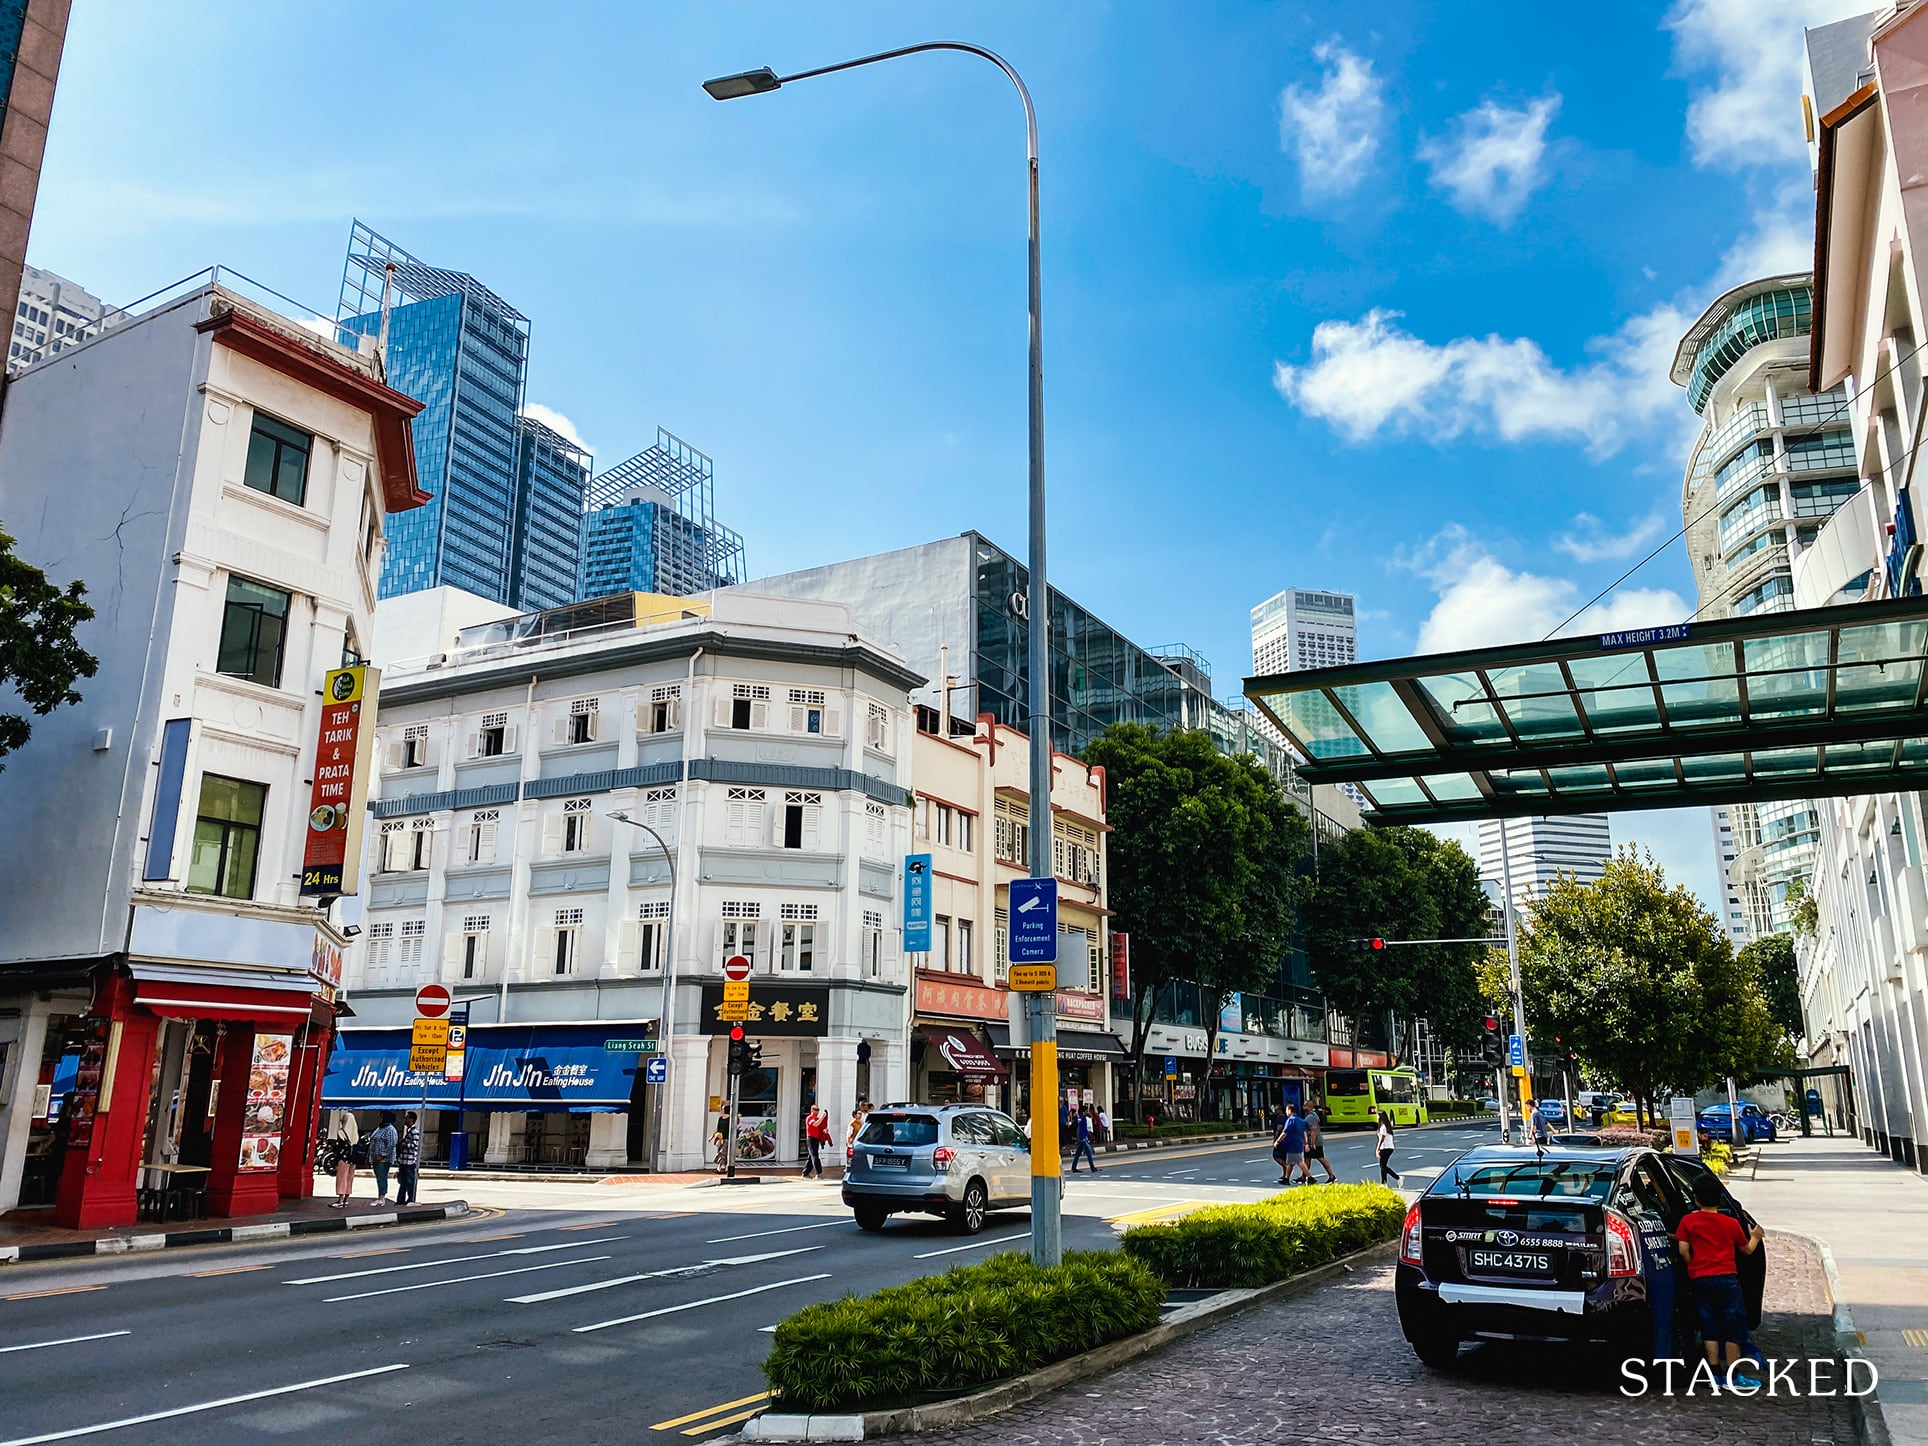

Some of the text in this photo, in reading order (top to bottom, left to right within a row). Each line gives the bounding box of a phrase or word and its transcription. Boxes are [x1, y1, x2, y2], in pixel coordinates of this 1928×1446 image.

[1602, 627, 1680, 646] MAX HEIGHT 3.2M
[332, 711, 349, 726] TEH
[325, 728, 352, 743] TARIK
[332, 747, 340, 760] &
[319, 764, 349, 780] PRATA
[321, 783, 344, 797] TIME
[304, 871, 339, 886] 24 Hrs
[1022, 922, 1044, 930] Parking
[1015, 934, 1051, 943] Enforcement
[417, 1046, 439, 1055] Except
[607, 1041, 655, 1051] Liang Seah St
[411, 1055, 445, 1063] Authorised
[404, 1076, 426, 1088] Eating
[543, 1076, 568, 1088] Eating
[567, 1076, 594, 1086] House
[1457, 1231, 1483, 1239] SMRT
[1520, 1237, 1564, 1248] 6555 8888
